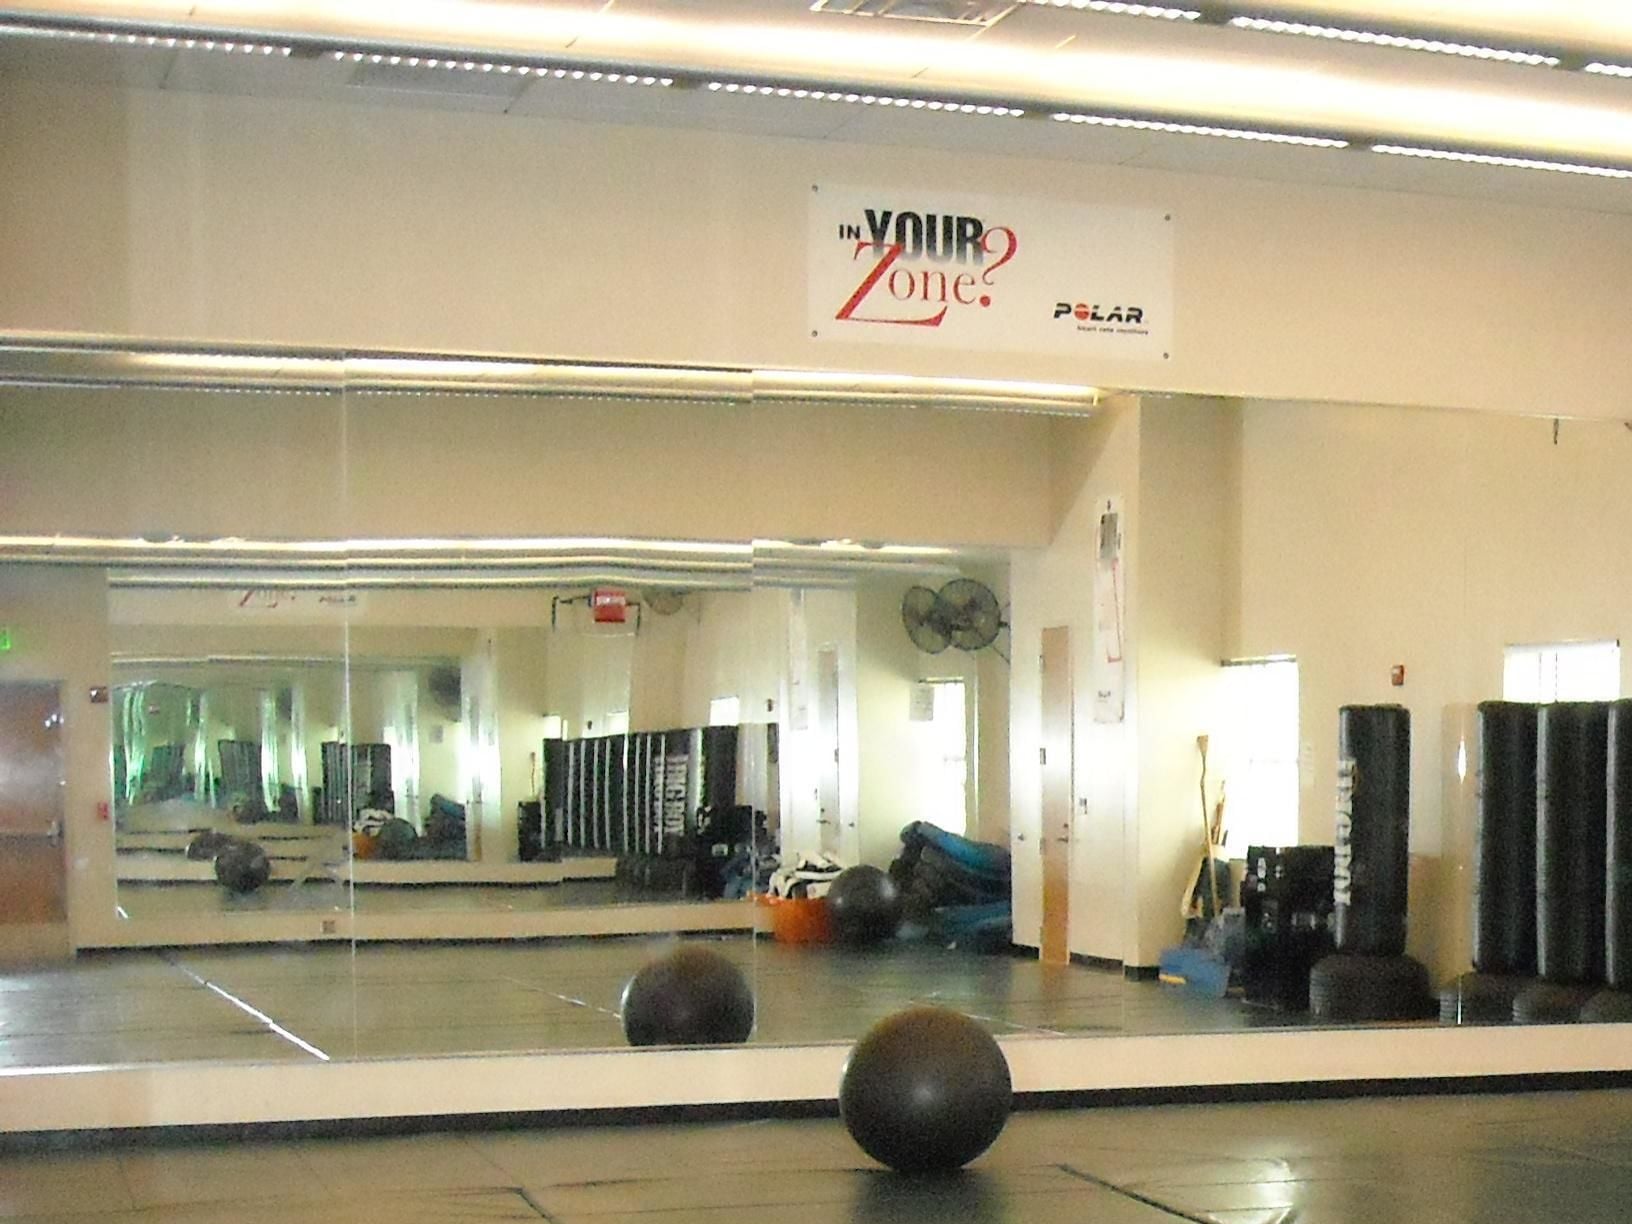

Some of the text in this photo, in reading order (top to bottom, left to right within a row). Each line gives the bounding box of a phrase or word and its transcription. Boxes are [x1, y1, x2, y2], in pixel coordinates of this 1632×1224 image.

[838, 208, 985, 266] IN YOUR
[1053, 302, 1143, 324] POLAR
